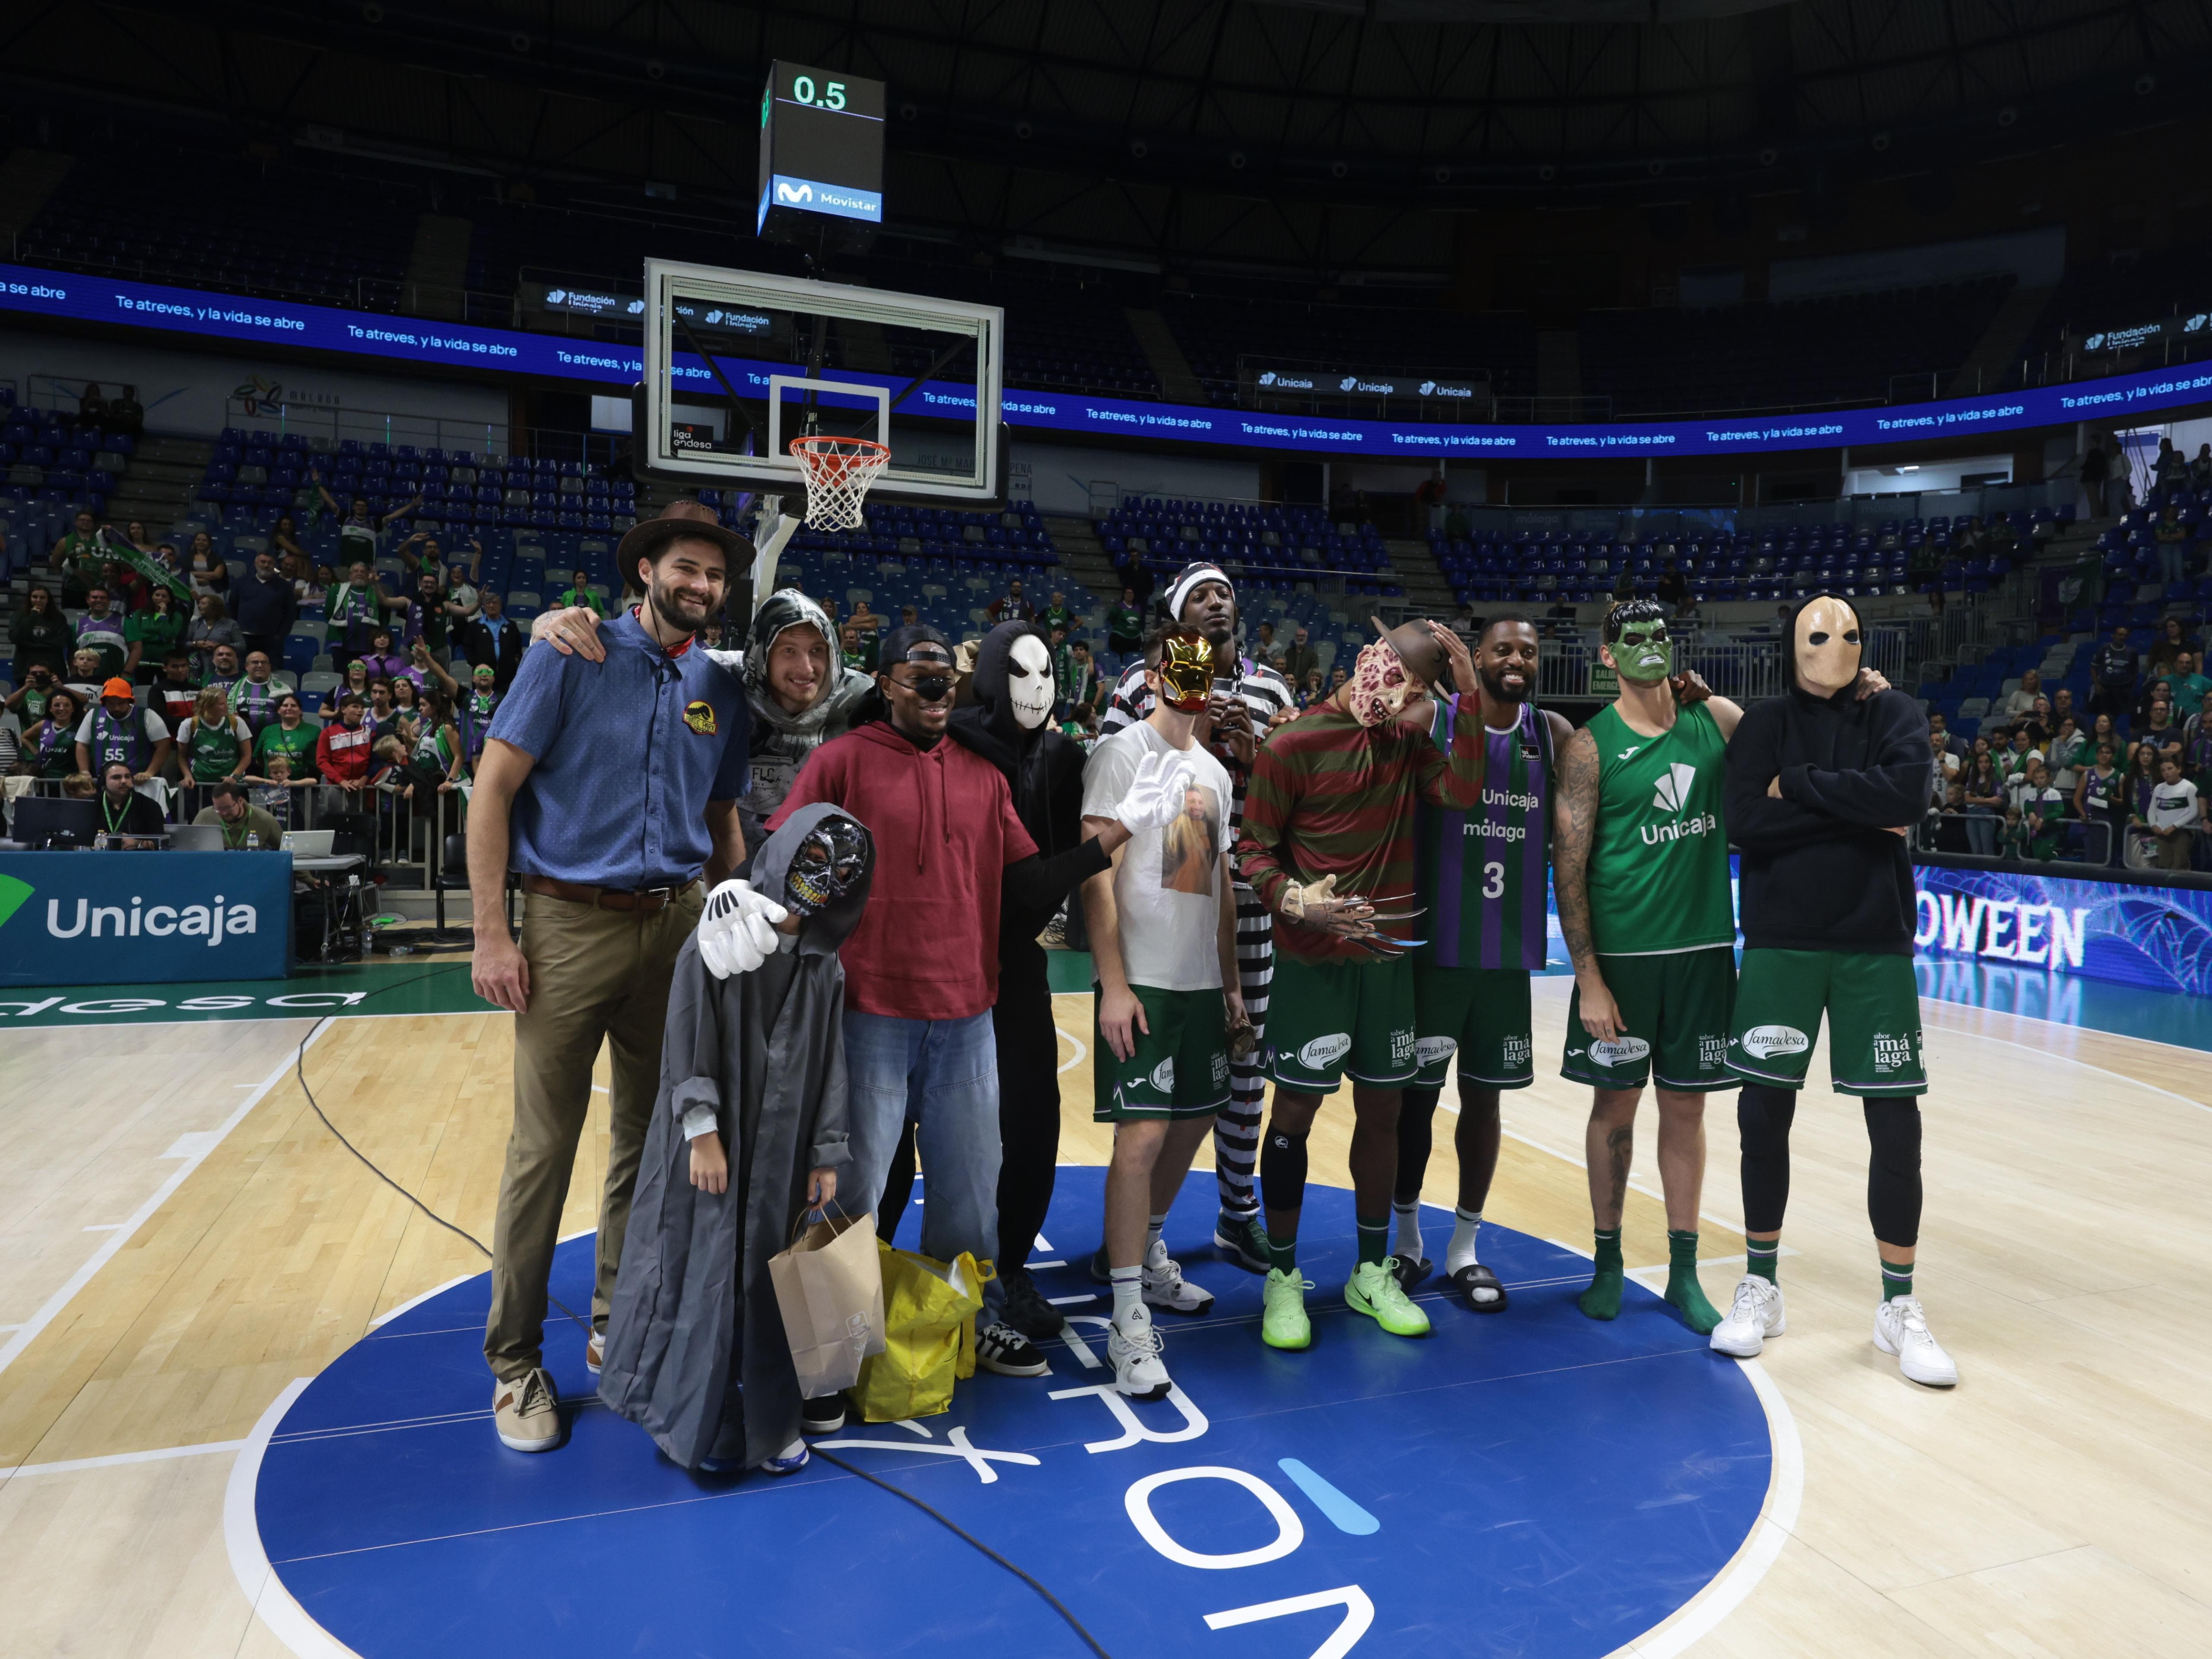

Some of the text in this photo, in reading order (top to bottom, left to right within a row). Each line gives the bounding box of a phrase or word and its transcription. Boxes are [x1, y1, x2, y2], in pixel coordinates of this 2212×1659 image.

[794, 76, 846, 110] 0.5
[821, 193, 877, 211] Movistar
[10, 283, 28, 294] se
[31, 285, 66, 299] abre
[569, 292, 615, 306] Fundación
[115, 295, 305, 330] Te atreves, y la vida se abre
[725, 312, 769, 325] Fundación
[347, 325, 517, 357] Te atreves, y la vida se abre
[2108, 324, 2161, 341] Fundación
[557, 351, 711, 379] Te atreves, y la se abre
[747, 373, 761, 384] Te
[1277, 377, 1313, 388] Unicaja
[1357, 382, 1393, 395] Unicaja
[1437, 386, 1471, 398] Unicaja
[2061, 376, 2212, 408] Te atreves, y la vida se abr
[923, 392, 935, 403] Te
[1019, 404, 1032, 412] se
[1033, 404, 1056, 415] abre
[1086, 408, 1212, 429] Te atreves, y la vida se abre
[1877, 406, 2024, 430] Te atreves, y la vida se abre
[674, 429, 691, 439] liga
[1241, 423, 1253, 433] Te
[1253, 425, 1290, 437] atreves,
[1292, 430, 1298, 439] y
[1299, 428, 1308, 437] la
[1308, 429, 1328, 439] vida
[1341, 431, 1363, 441] abre
[1392, 433, 1404, 443] Te
[1404, 435, 1442, 445] atreves,
[1443, 437, 1450, 446] y
[1451, 436, 1459, 445] la
[1460, 436, 1480, 445] vida
[1494, 436, 1516, 446] abre
[1546, 436, 1558, 446] Te
[1559, 437, 1598, 446] atreves,
[1600, 438, 1606, 447] y
[1607, 436, 1616, 445] la
[1617, 435, 1638, 444] vida
[1652, 434, 1675, 444] abre
[1706, 425, 1843, 441] Te atreves, y la vida se abre
[674, 439, 712, 449] endesa
[918, 454, 937, 466] JOSÉ
[702, 721, 717, 732] PARK
[105, 748, 125, 762] 55
[1482, 789, 1538, 812] Unicaja
[1463, 818, 1526, 842] málaga
[1641, 811, 1716, 845] Unicaja
[1482, 861, 1504, 899] 3
[47, 895, 257, 946] Unicaja
[1745, 1028, 1805, 1047] famadesa
[1391, 1043, 1414, 1060] laga
[1415, 1039, 1455, 1054] amadesa
[1593, 1040, 1646, 1057] famadesa
[1503, 1047, 1530, 1064] laga
[1874, 1048, 1912, 1067] laga
